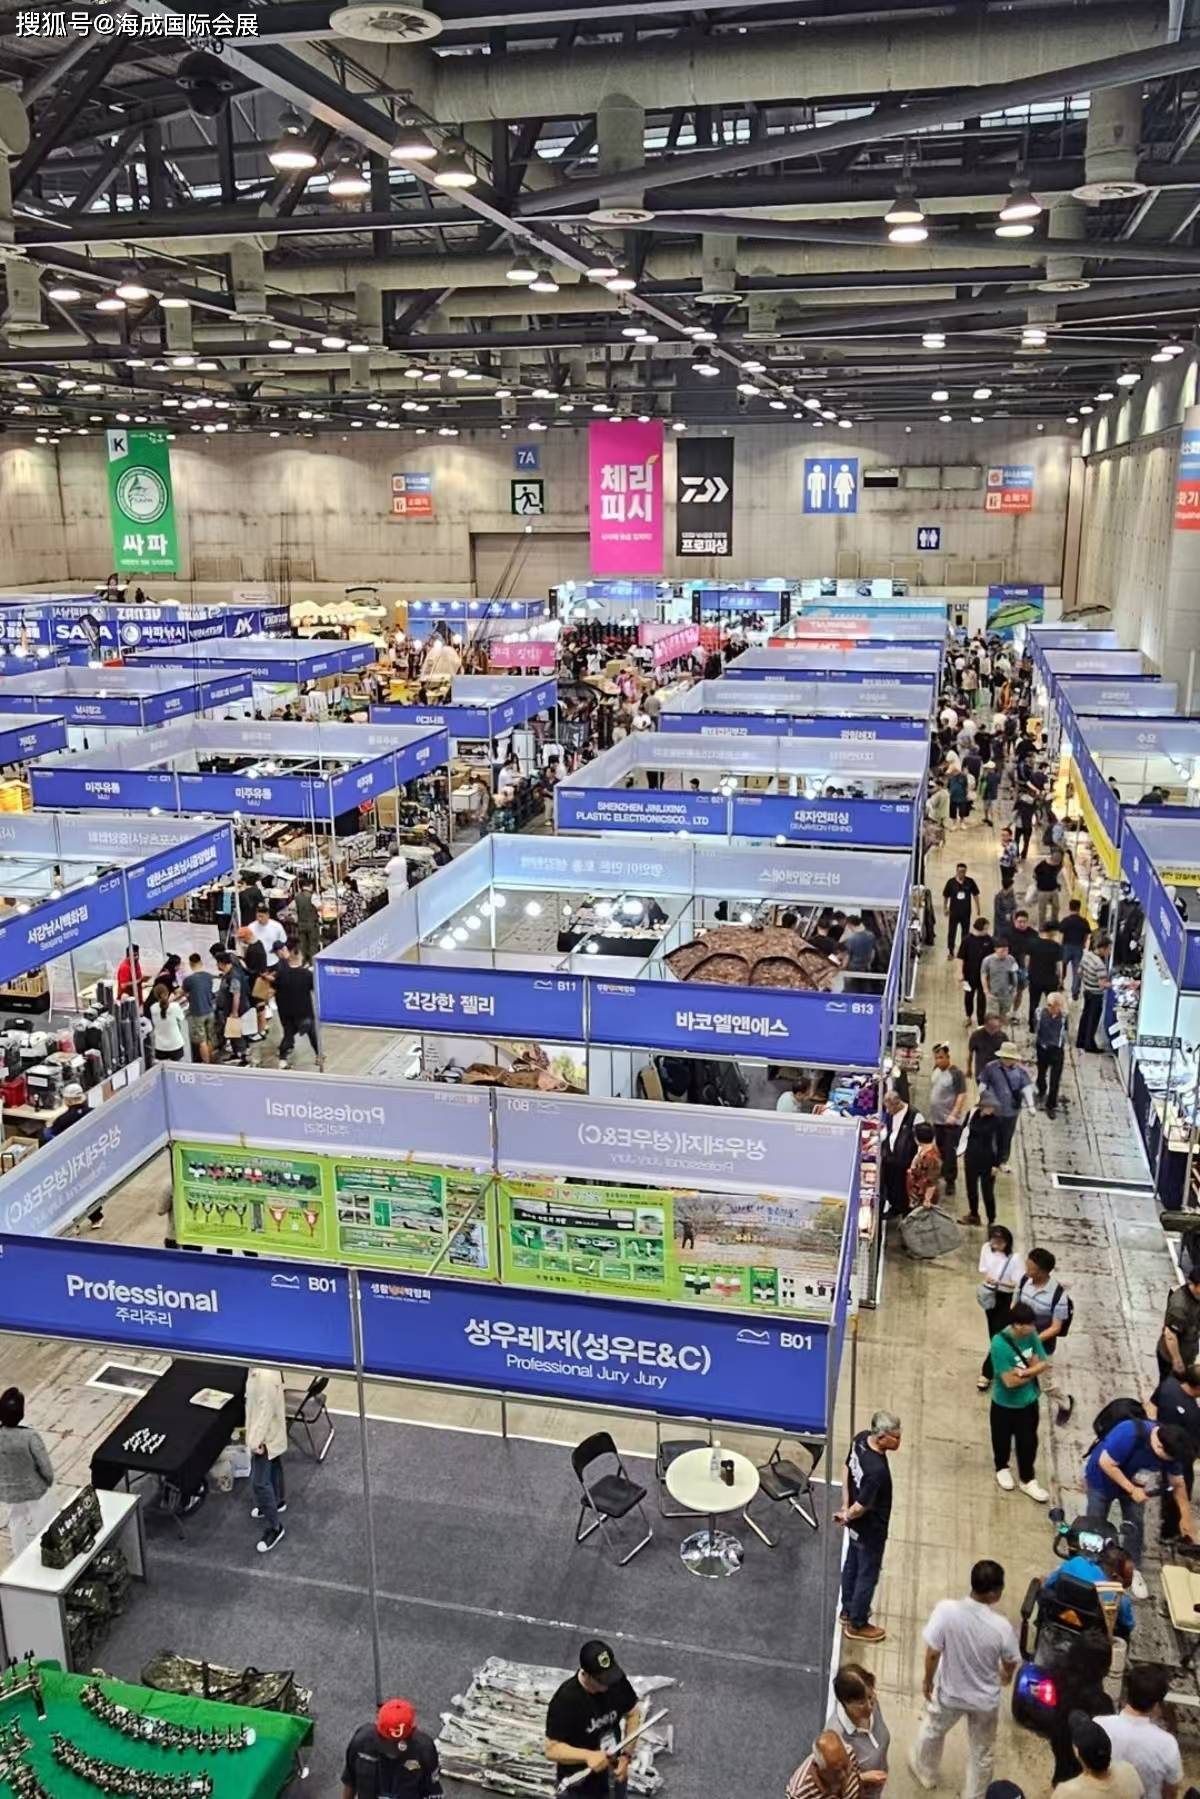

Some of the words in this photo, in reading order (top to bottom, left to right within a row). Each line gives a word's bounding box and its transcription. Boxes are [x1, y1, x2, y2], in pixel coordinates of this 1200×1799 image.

[114, 438, 125, 452] K
[518, 452, 536, 464] 7A
[600, 464, 654, 493] 체리
[601, 494, 653, 522] 피시
[56, 625, 112, 640] SAA
[576, 811, 611, 822] PLASTIC
[692, 816, 709, 825] LTD
[795, 810, 849, 825] 대자연피싱
[557, 982, 576, 992] B11
[403, 991, 455, 1012] 건강한
[460, 995, 495, 1016] 젤리
[852, 1002, 874, 1015] B13
[675, 1010, 789, 1037] 바코엘앤에스
[66, 1274, 218, 1312] Professional
[308, 1276, 337, 1293] B01
[115, 1306, 172, 1329] 주리주리
[464, 1318, 711, 1375] 성우레저(성우E&C)
[780, 1332, 812, 1350] B01
[506, 1353, 593, 1378] Professional
[596, 1366, 630, 1385] Jury
[633, 1370, 668, 1390] Jury
[585, 1710, 617, 1733] Jeep
